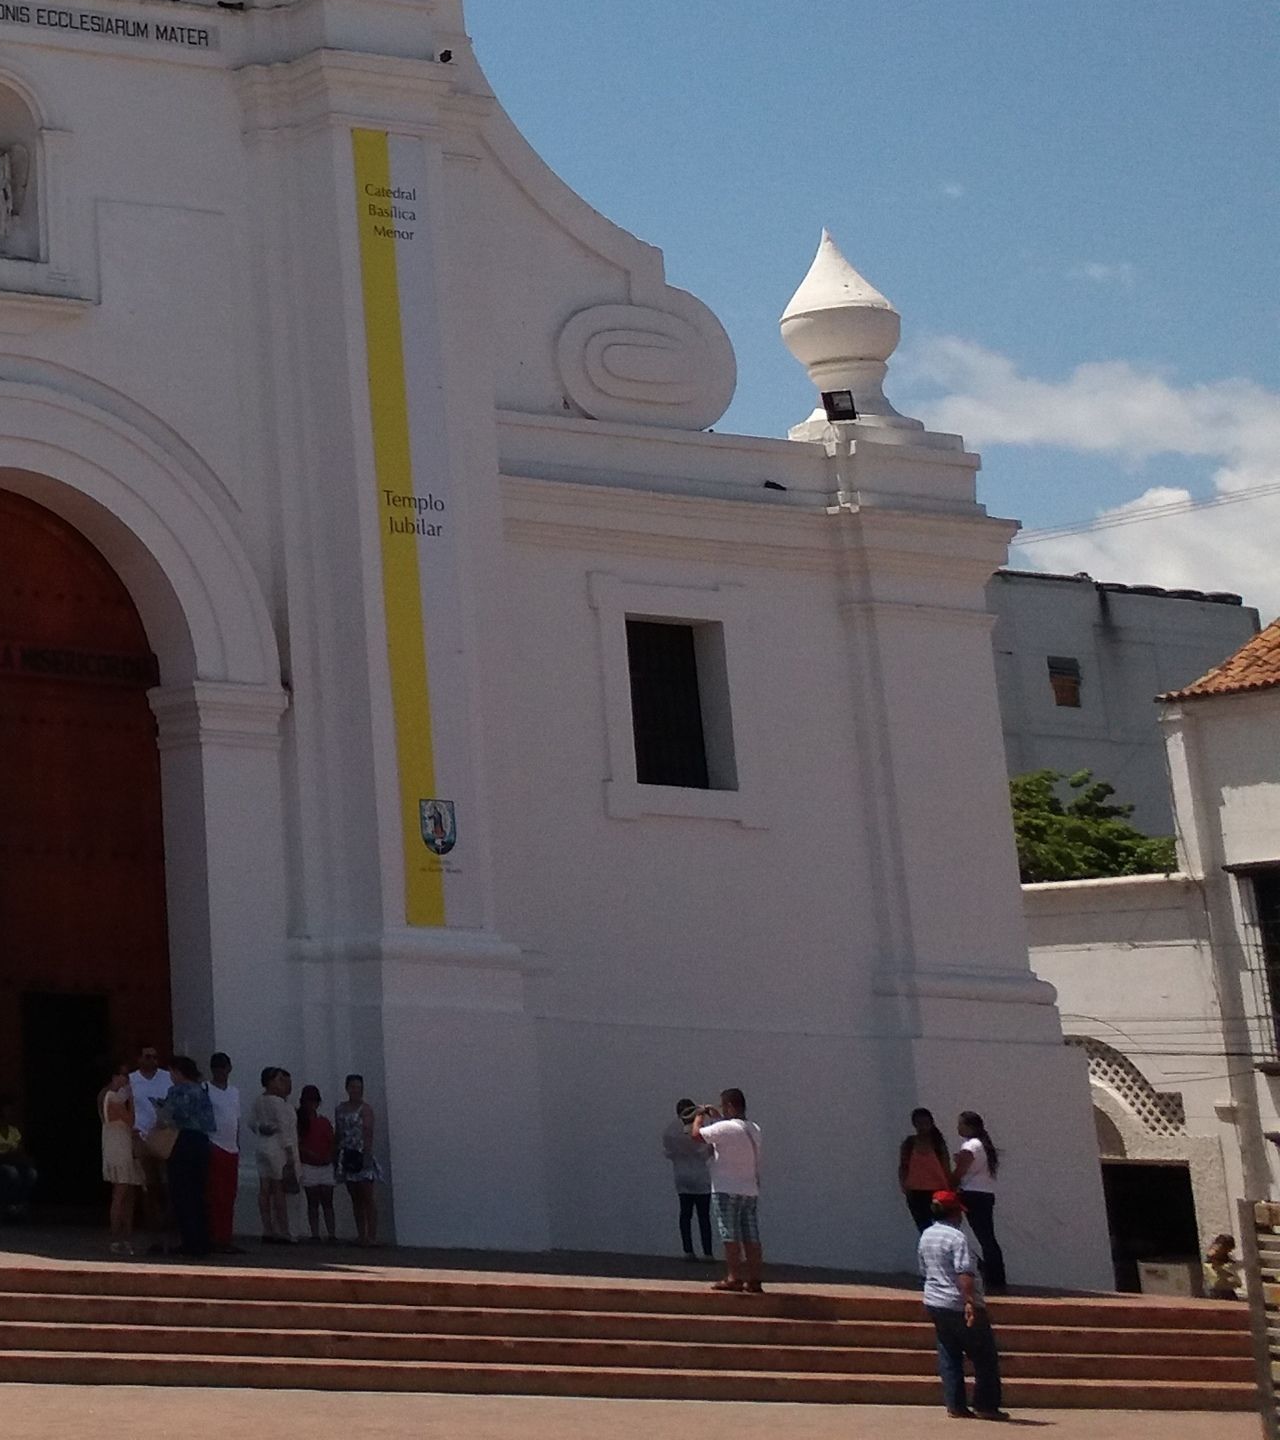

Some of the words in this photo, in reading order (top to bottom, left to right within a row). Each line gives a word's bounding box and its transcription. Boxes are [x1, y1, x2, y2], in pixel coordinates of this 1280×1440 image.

[36, 8, 150, 38] ECCLESIARUM
[155, 24, 209, 47] MATER
[364, 183, 417, 201] Catedral
[373, 225, 415, 241] Menor
[383, 489, 445, 515] Templo
